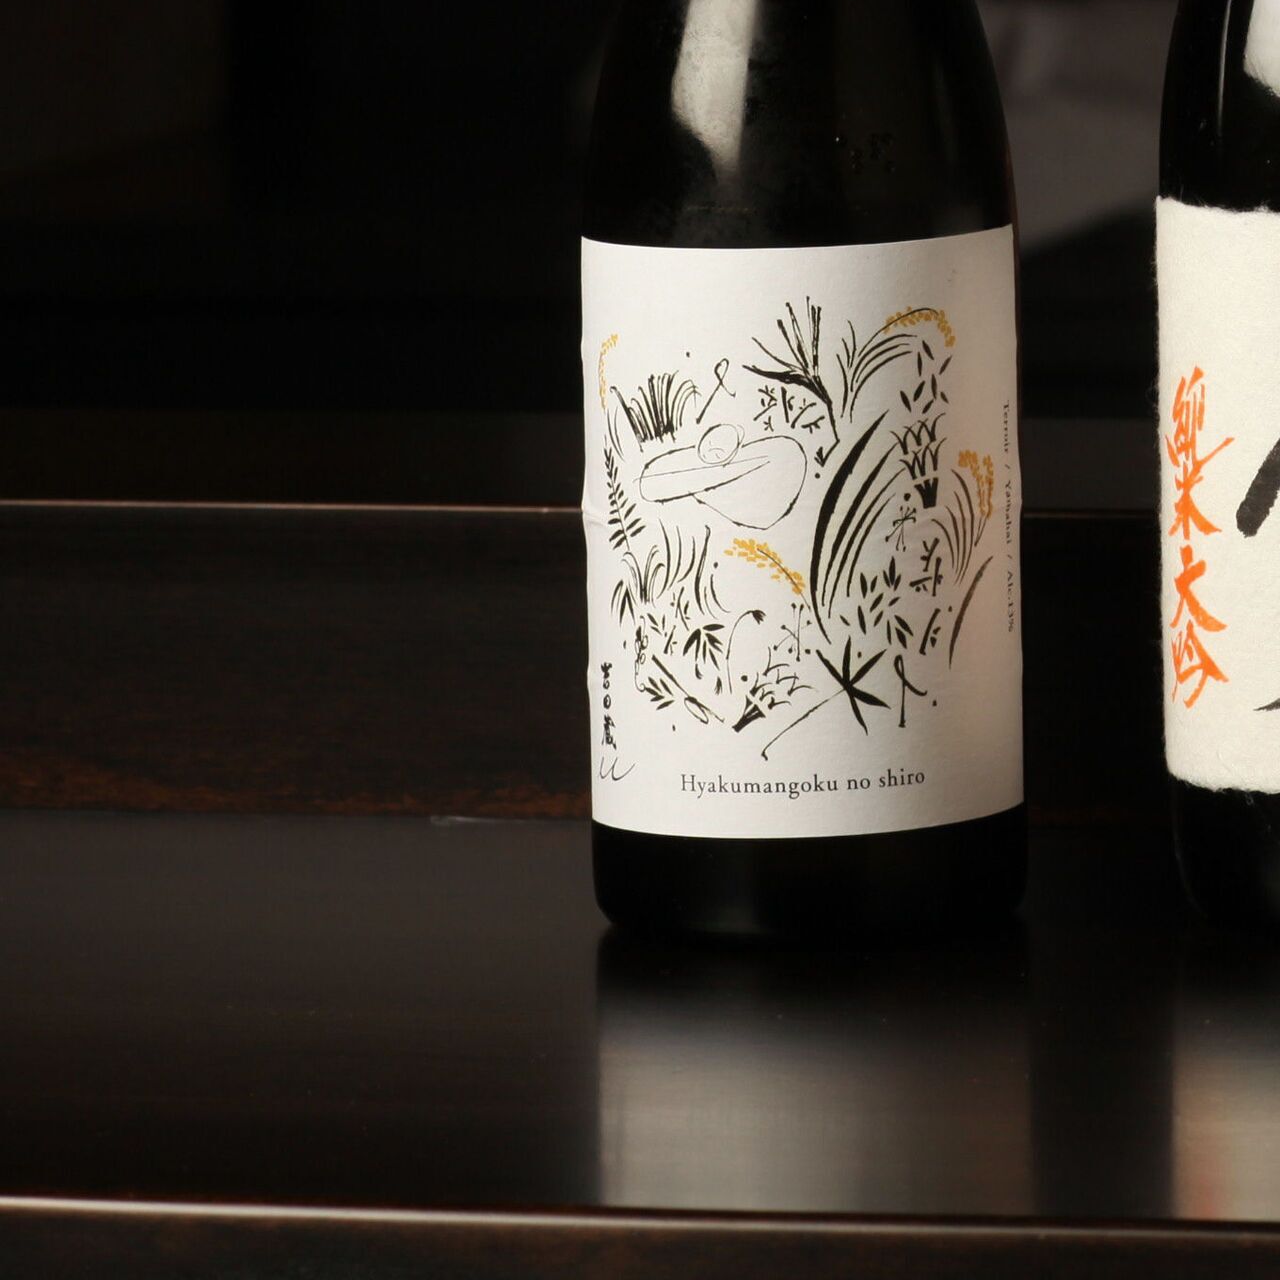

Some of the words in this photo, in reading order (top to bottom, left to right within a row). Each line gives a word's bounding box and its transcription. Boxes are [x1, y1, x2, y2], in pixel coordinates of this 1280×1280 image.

[680, 773, 839, 800] Hyakumangoku
[846, 777, 871, 791] no
[878, 767, 926, 788] shiro
